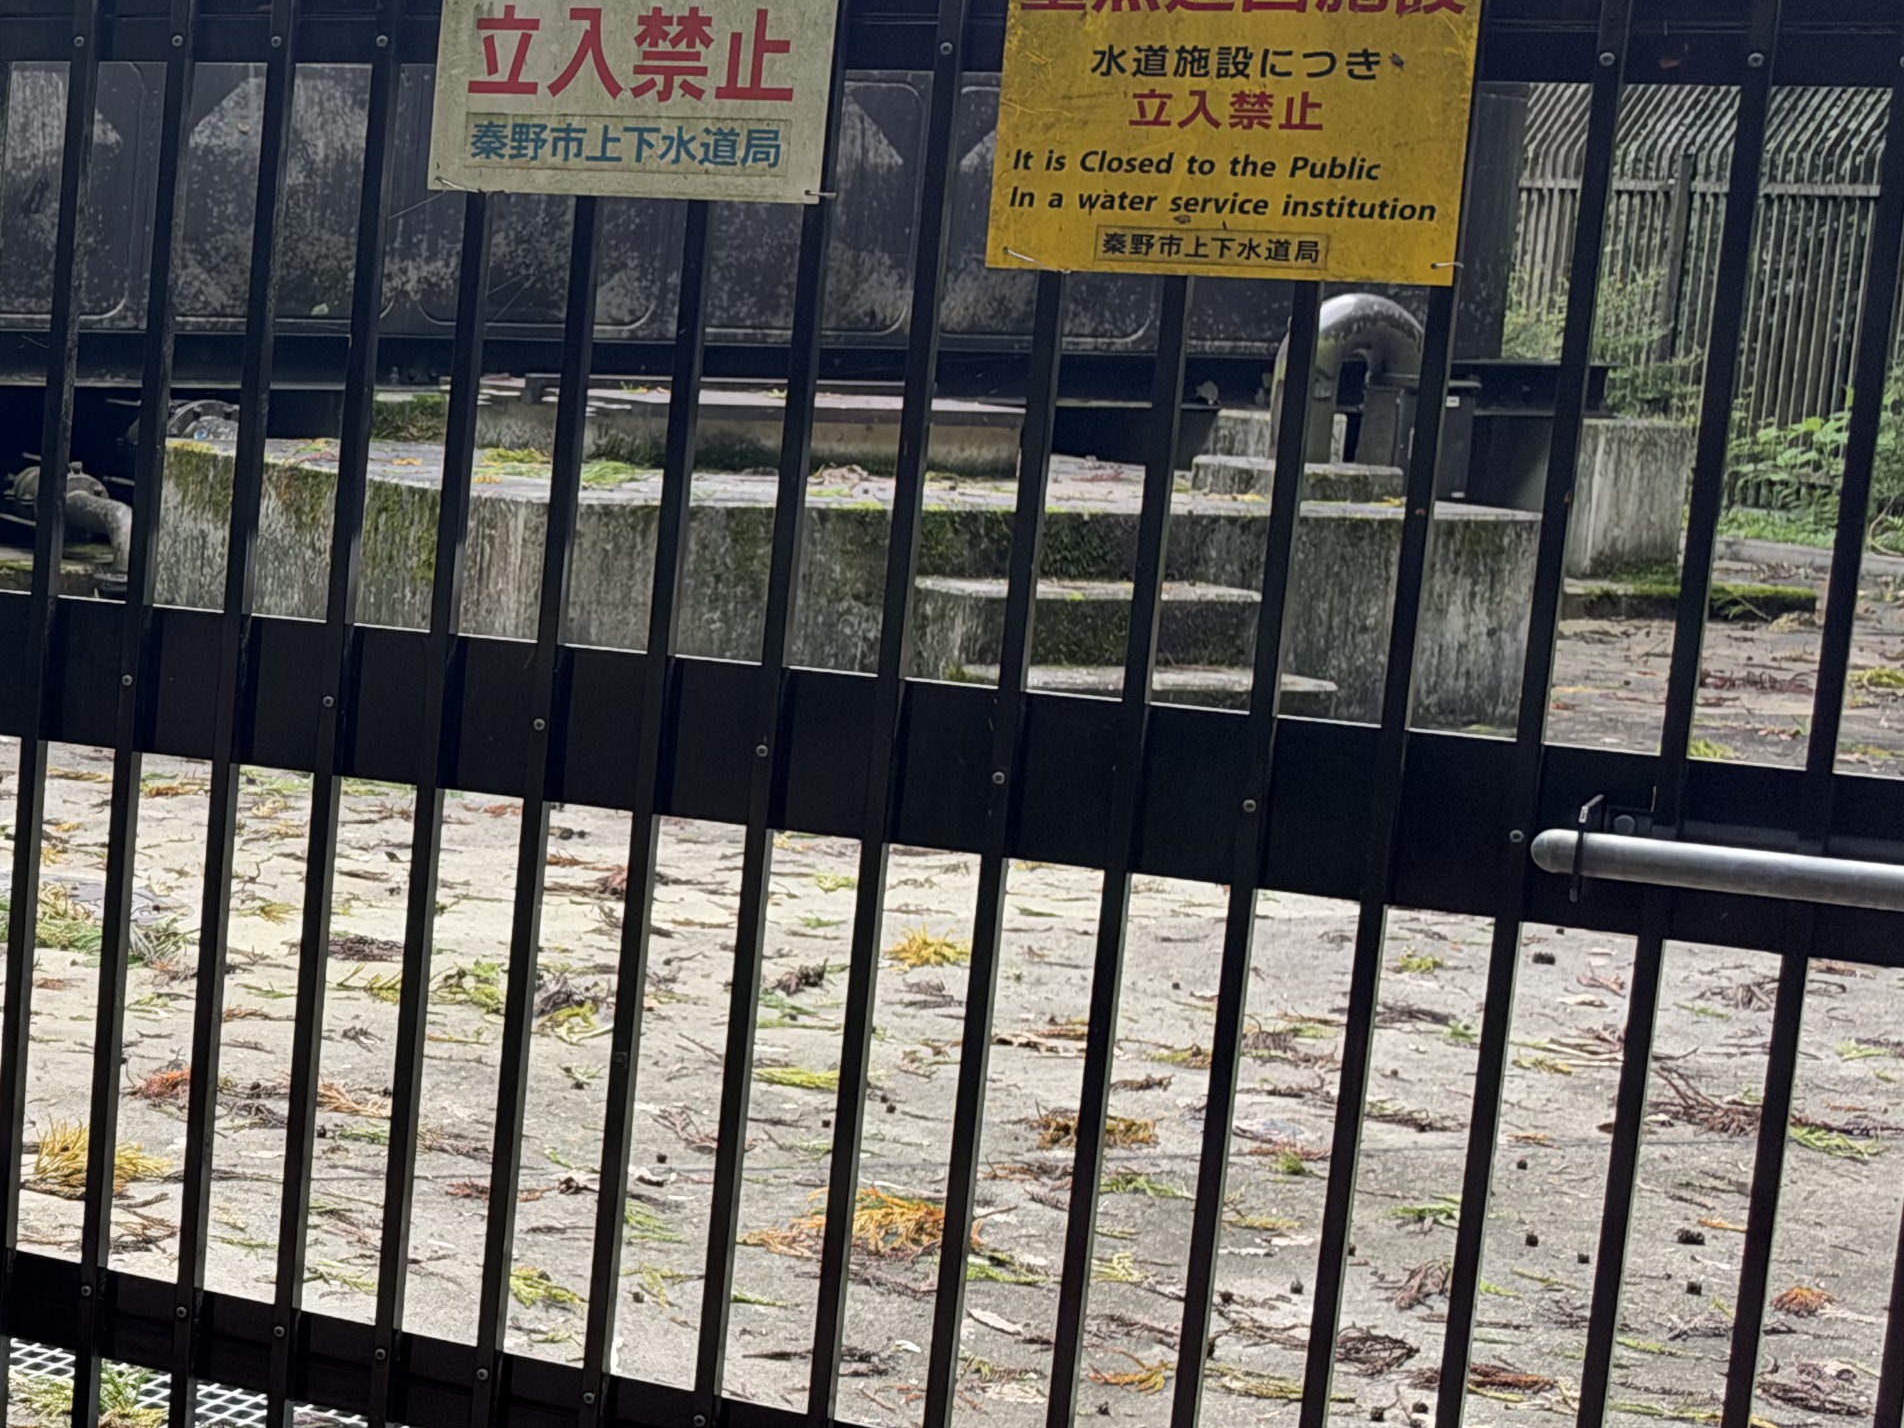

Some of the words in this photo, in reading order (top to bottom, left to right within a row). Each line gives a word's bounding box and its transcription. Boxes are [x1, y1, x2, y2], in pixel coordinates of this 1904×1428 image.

[467, 4, 795, 103] 立入禁止
[1090, 44, 1382, 81] 水道施設につき
[1128, 88, 1325, 131] 立入禁止
[470, 121, 782, 170] 秦野市上下水道局
[1012, 149, 1034, 172] It
[1045, 149, 1066, 172] is
[1079, 149, 1175, 176] Closed
[1187, 155, 1216, 176] to
[1229, 153, 1277, 178] the
[1289, 155, 1382, 182] Public
[1009, 186, 1035, 209] In
[1048, 193, 1063, 210] a
[1078, 189, 1158, 212] water
[1169, 191, 1269, 216] service
[1281, 192, 1437, 223] institution
[1102, 230, 1321, 264] 秦野市上下水道局
